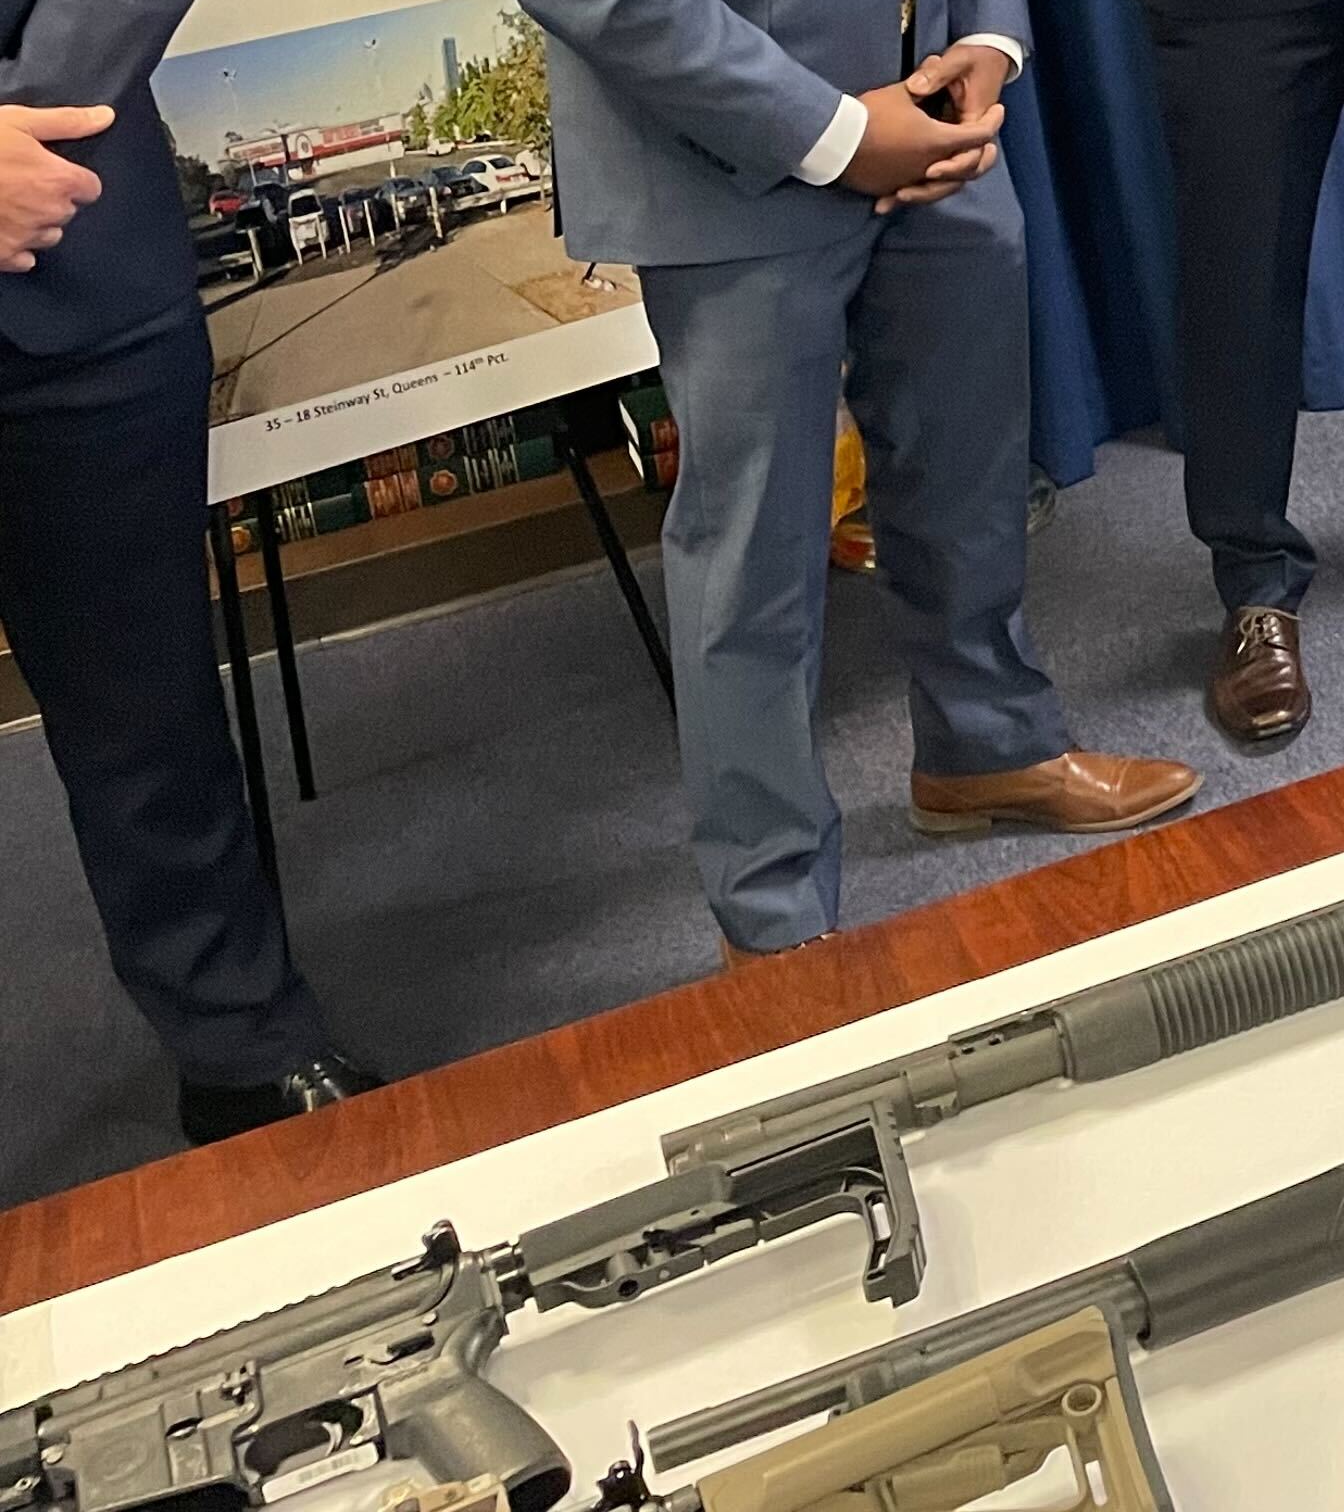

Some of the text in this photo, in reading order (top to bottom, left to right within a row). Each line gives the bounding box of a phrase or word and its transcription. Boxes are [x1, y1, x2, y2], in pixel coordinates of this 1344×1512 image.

[264, 418, 282, 432] 35
[296, 409, 311, 424] 18
[313, 392, 371, 419] Steinway
[372, 388, 390, 402] St,
[391, 372, 439, 395] Queens
